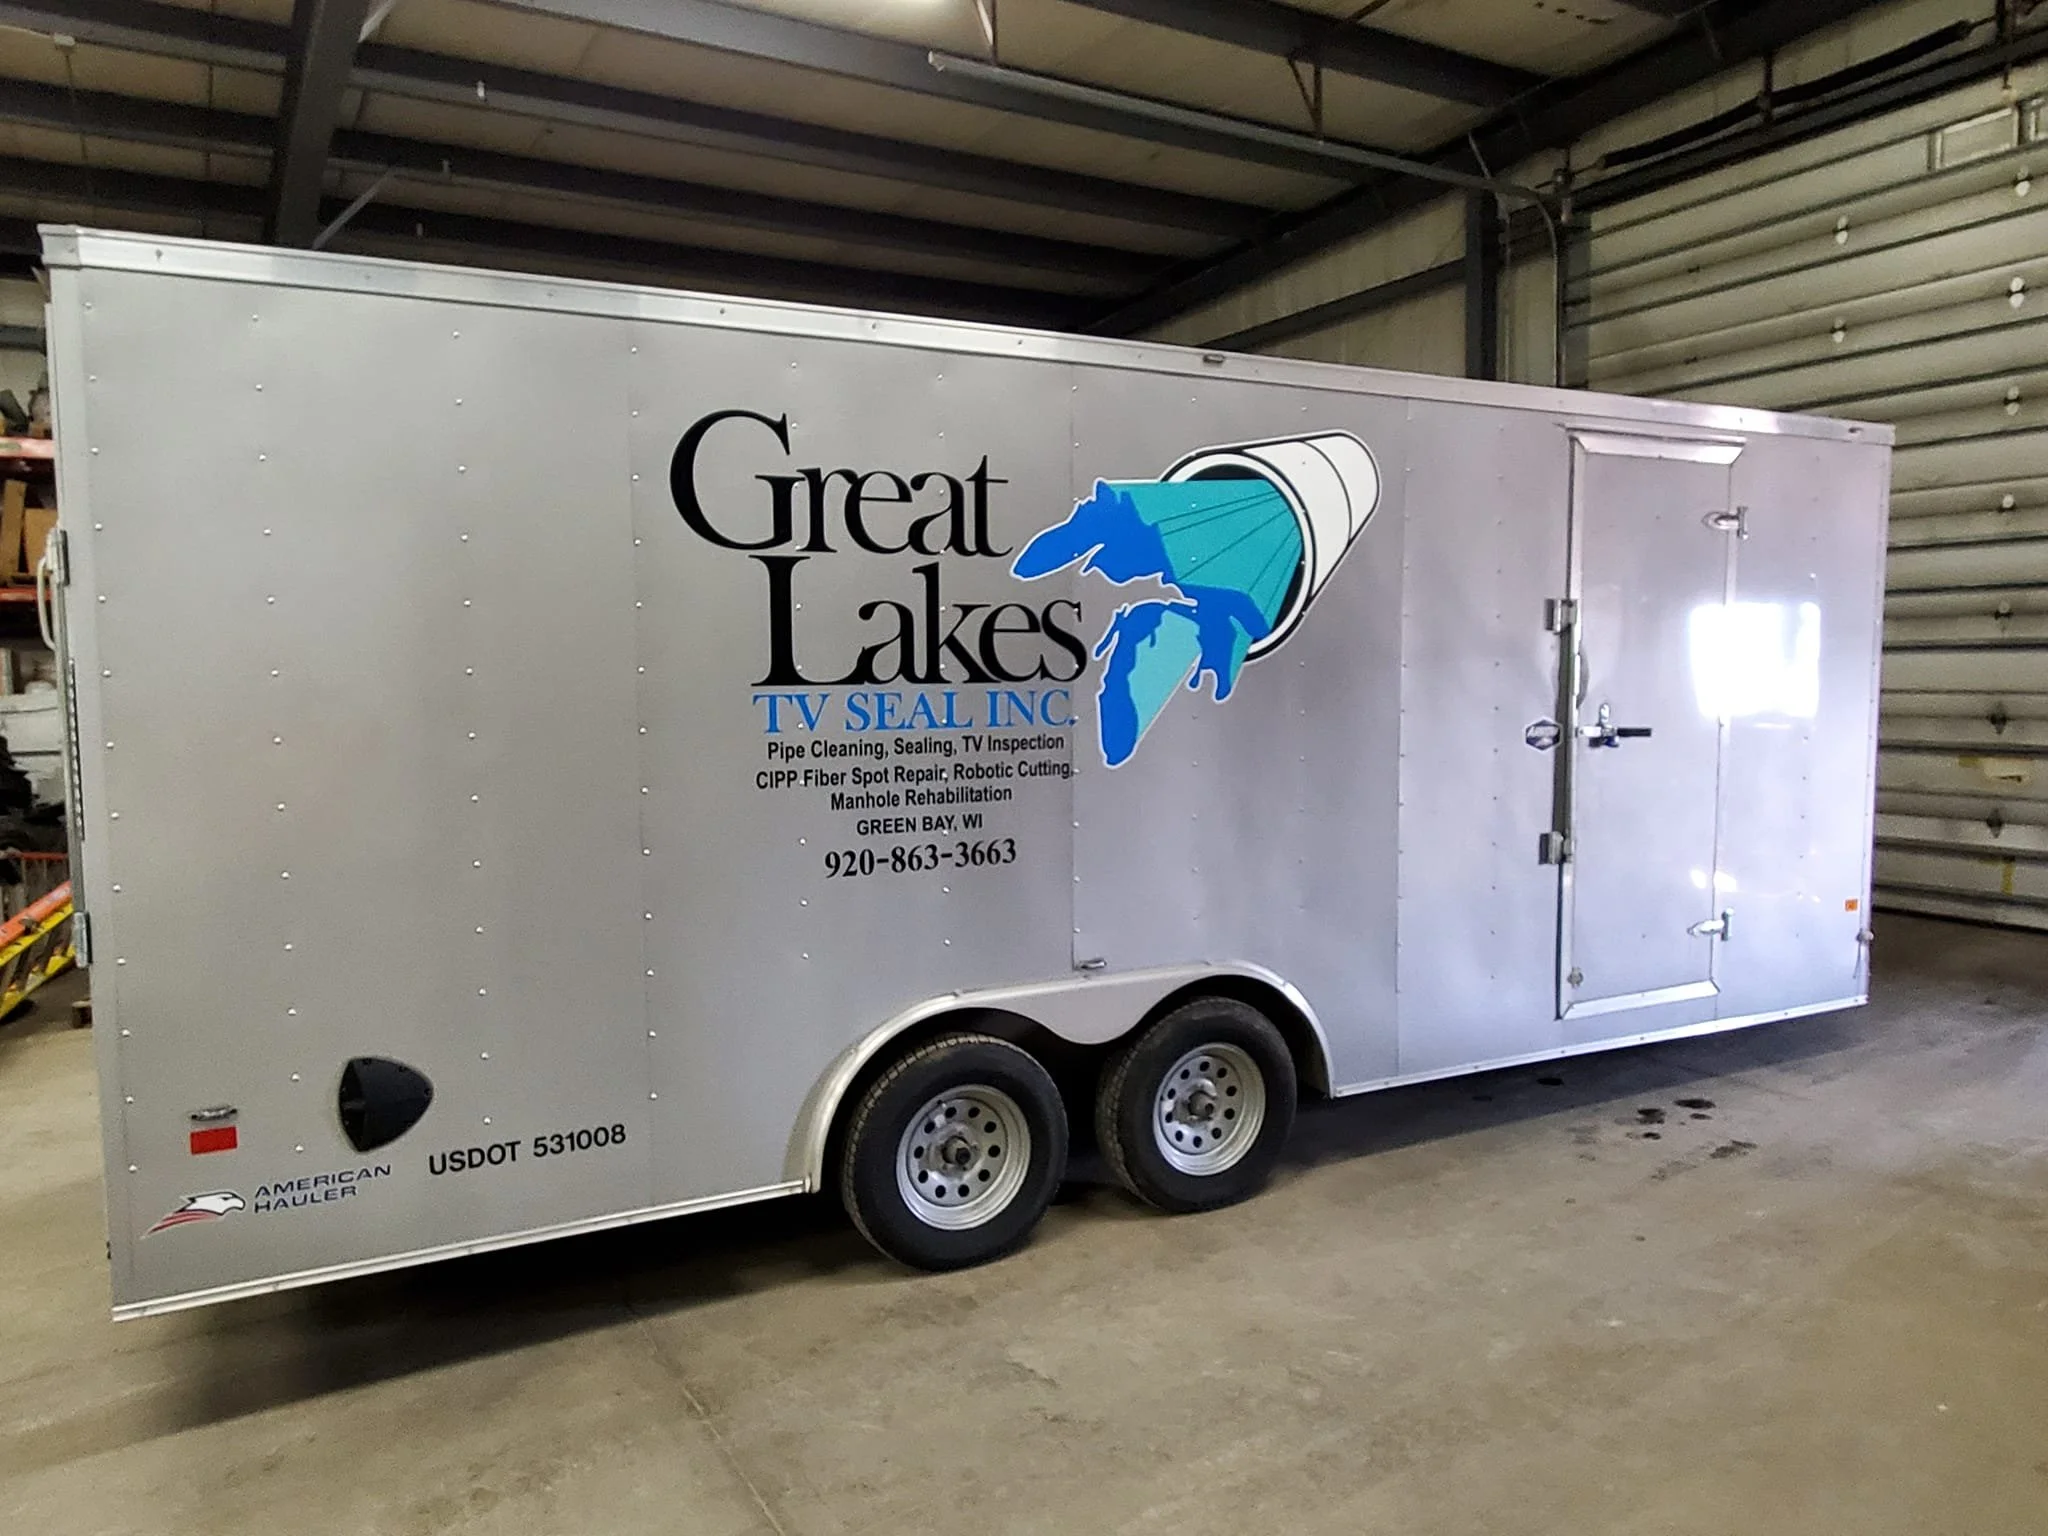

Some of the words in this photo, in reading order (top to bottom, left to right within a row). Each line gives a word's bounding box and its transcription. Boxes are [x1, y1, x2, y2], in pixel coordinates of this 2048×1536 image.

[669, 408, 1013, 557] Great
[748, 554, 1088, 687] Lakes
[753, 692, 830, 735] TV
[846, 690, 972, 732] SEAL
[986, 689, 1075, 728] INC.
[768, 741, 805, 763] Pipe
[810, 738, 889, 759] Cleaning,
[894, 737, 957, 756] Sealing,
[962, 735, 983, 751] TV
[988, 733, 1064, 754] Inspection
[756, 770, 797, 789] CIPP
[804, 770, 846, 786] Fiber
[851, 767, 889, 788] Spot
[894, 764, 948, 784] Repair,
[953, 763, 1013, 780] Robotic
[831, 790, 900, 810] Manhole
[905, 785, 1012, 806] Rehabilitation
[856, 817, 917, 835] GREEN
[922, 815, 958, 832] BAY,
[962, 813, 983, 829] WI
[825, 838, 1017, 878] 920-863-3663
[428, 1142, 521, 1176] USDOT
[532, 1123, 627, 1158] 531008
[255, 1164, 392, 1198] AMERICAN
[254, 1185, 357, 1214] HAULER
